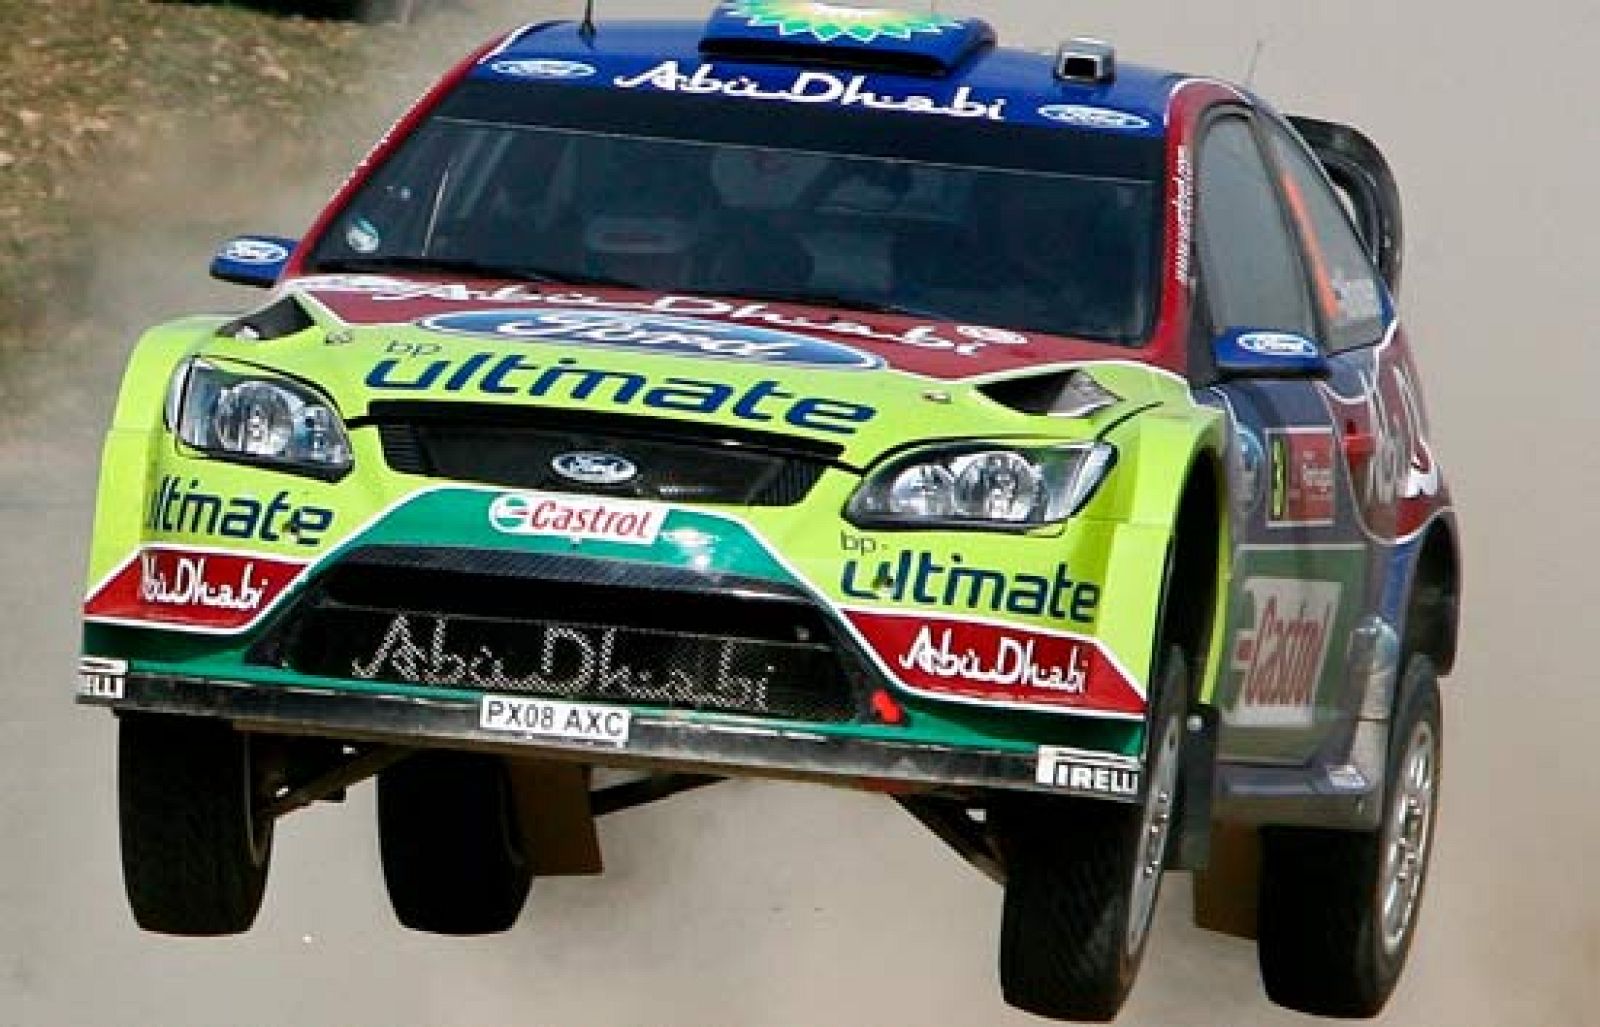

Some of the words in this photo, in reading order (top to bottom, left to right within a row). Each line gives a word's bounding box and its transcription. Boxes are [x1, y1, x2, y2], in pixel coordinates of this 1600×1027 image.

[614, 60, 780, 98] Abu
[789, 72, 1006, 121] Dhabi
[387, 340, 441, 356] bp
[495, 312, 798, 358] Ford
[364, 353, 876, 434] ultimate
[531, 502, 652, 538] Castrol
[841, 530, 876, 556] bp
[841, 550, 1101, 622] ultimate
[351, 613, 506, 689] Abu
[540, 623, 776, 711] Dhabi
[899, 625, 982, 680] Abu
[994, 636, 1088, 693] Dhabi
[1244, 594, 1331, 706] Castrol
[486, 700, 555, 728] PX08
[563, 707, 625, 737] AXC
